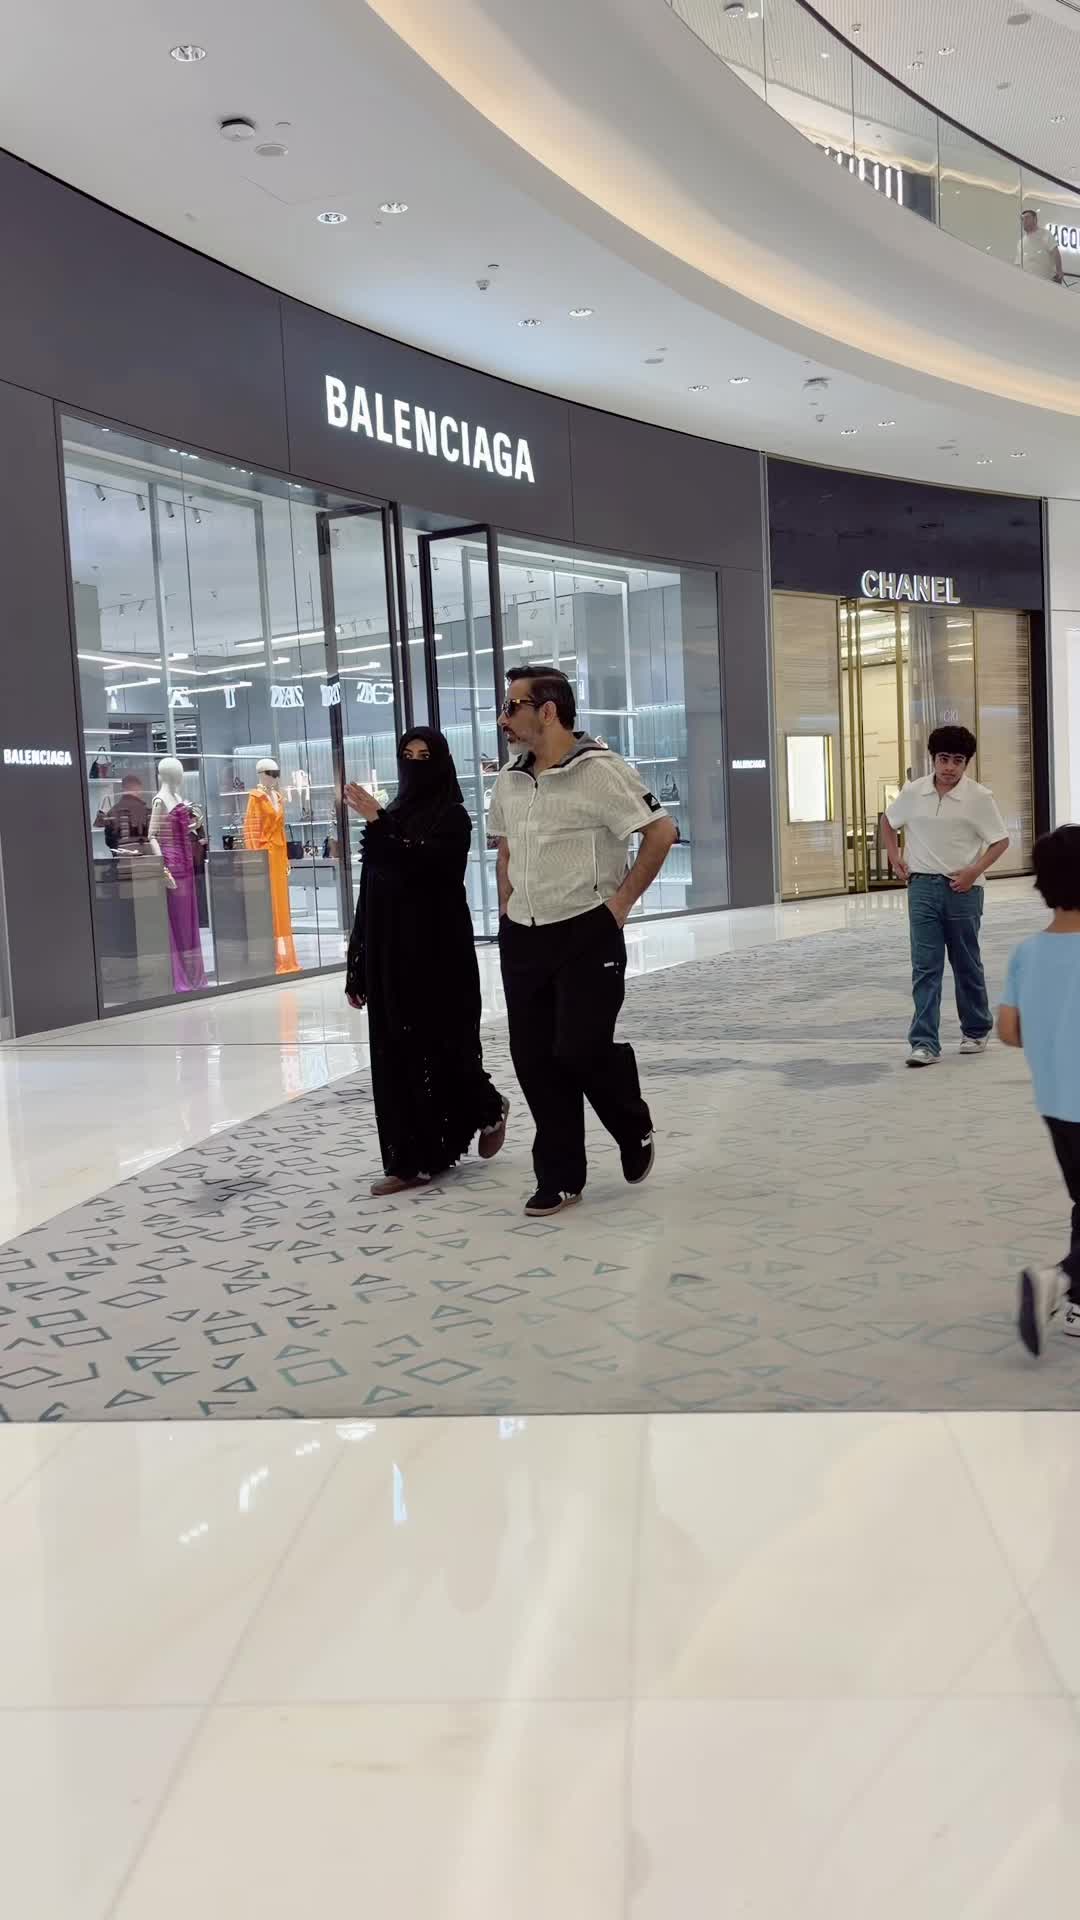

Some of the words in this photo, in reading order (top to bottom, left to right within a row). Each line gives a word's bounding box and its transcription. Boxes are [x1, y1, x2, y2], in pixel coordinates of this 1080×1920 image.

[325, 374, 536, 483] BALENCIAGA
[861, 569, 961, 604] CHANEL
[3, 748, 73, 766] BALENCIAGA
